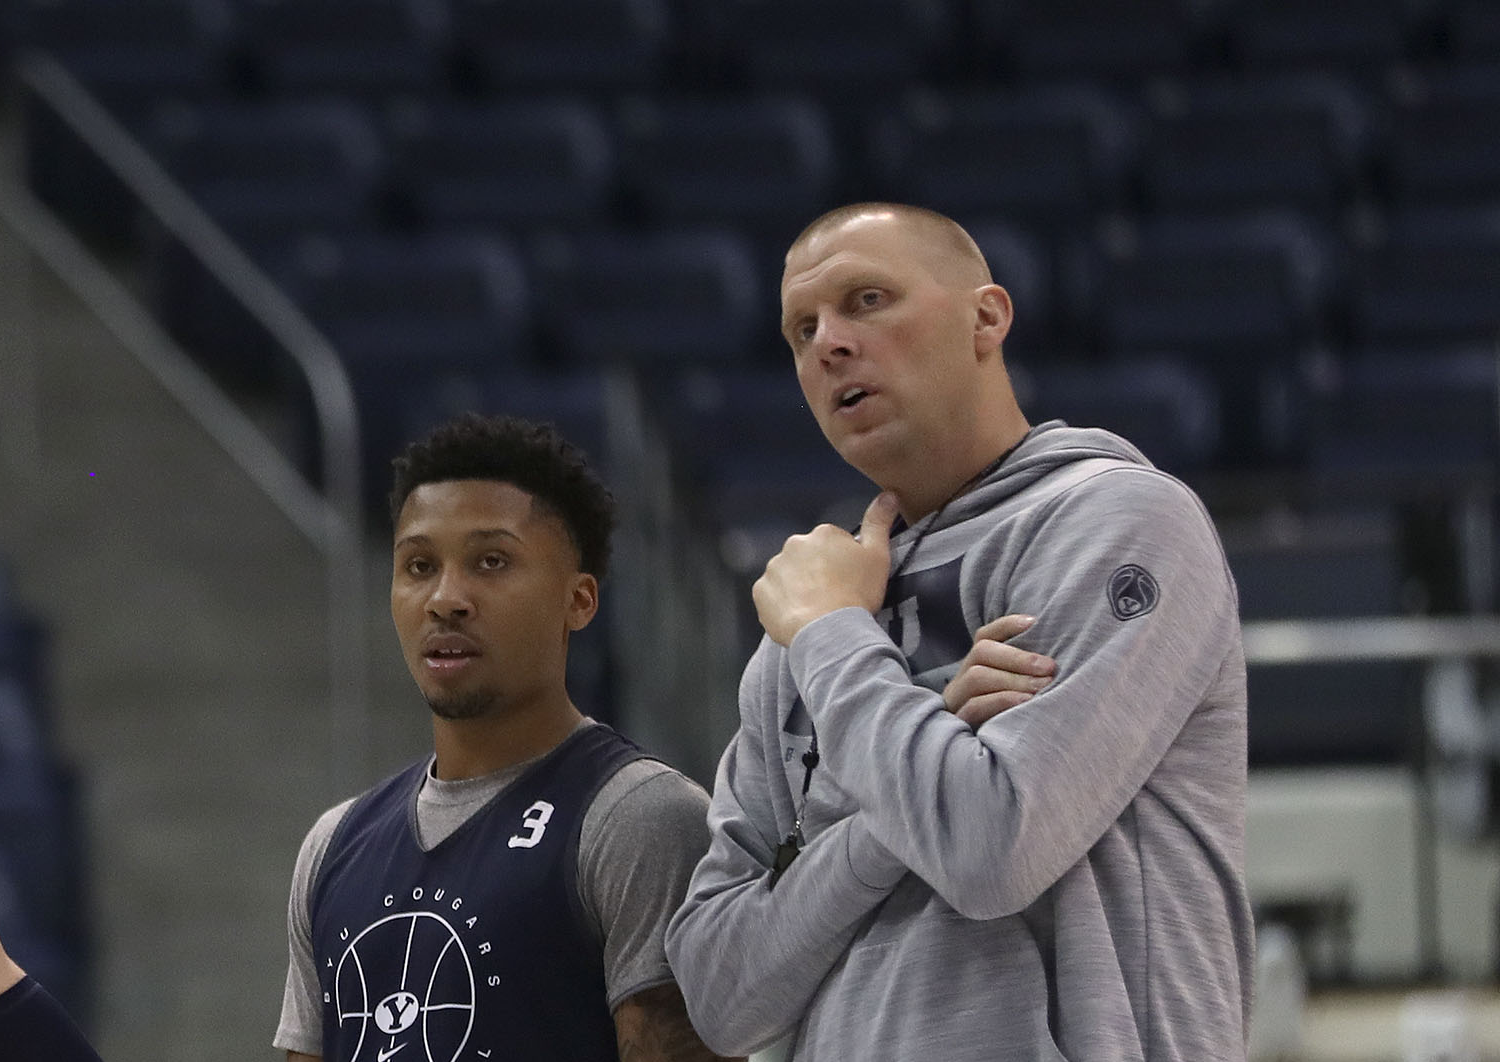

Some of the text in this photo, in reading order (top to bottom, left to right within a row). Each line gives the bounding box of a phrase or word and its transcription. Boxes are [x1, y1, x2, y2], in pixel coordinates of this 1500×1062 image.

[508, 800, 555, 848] 3
[383, 887, 500, 987] COUGARS
[384, 997, 414, 1030] Y
